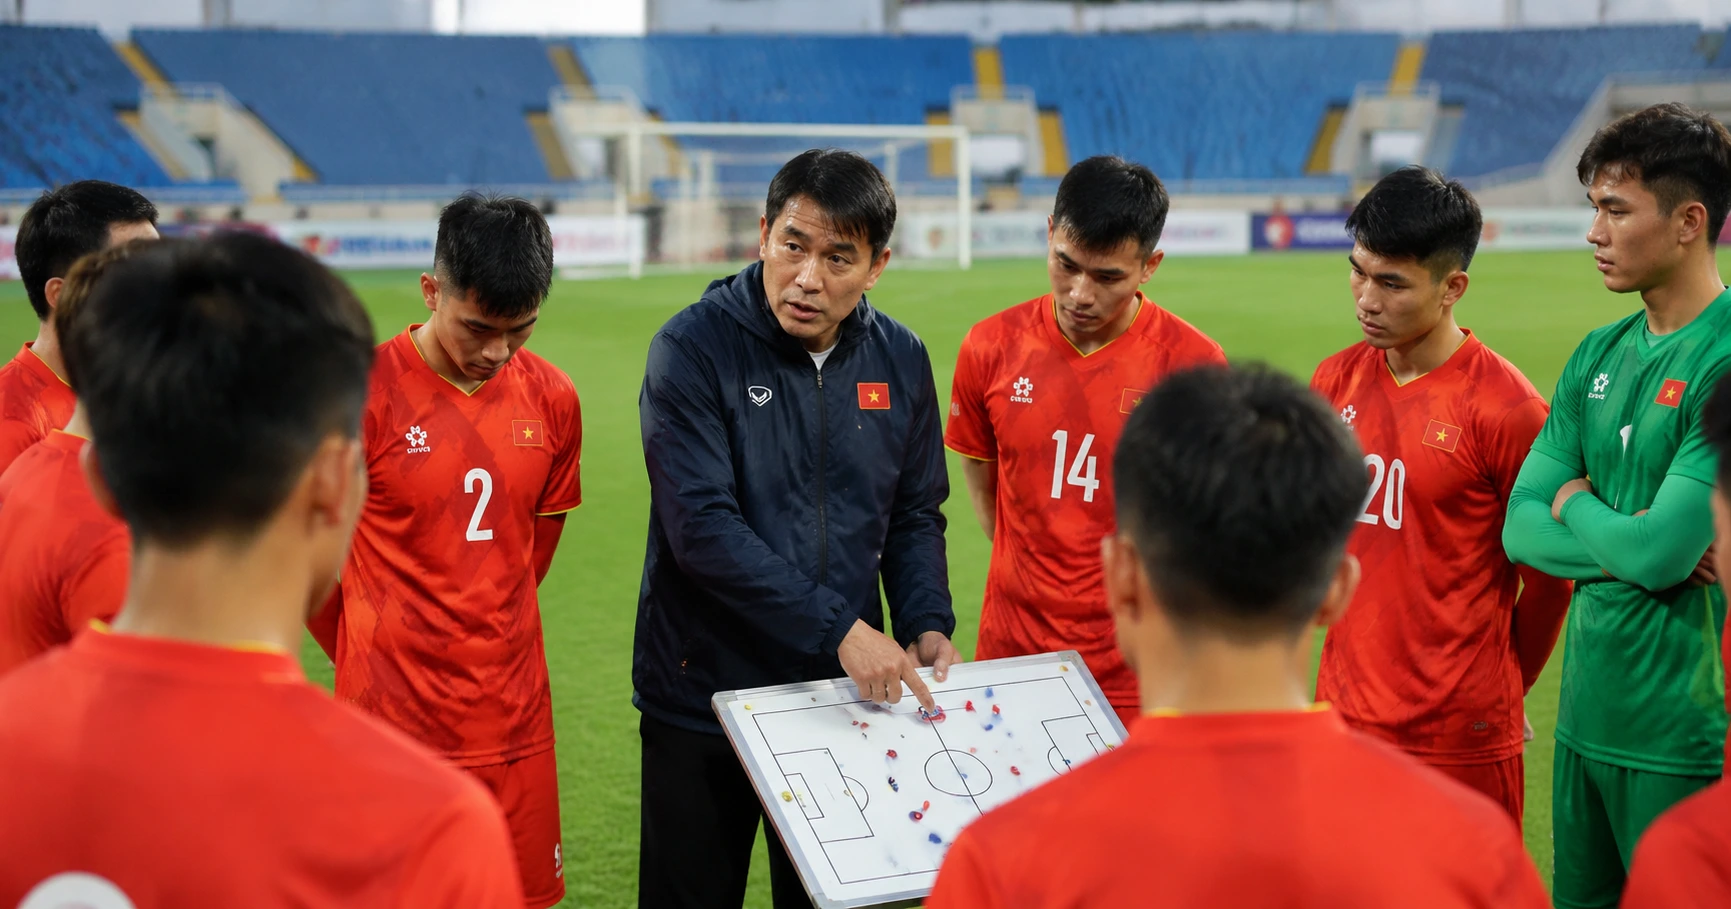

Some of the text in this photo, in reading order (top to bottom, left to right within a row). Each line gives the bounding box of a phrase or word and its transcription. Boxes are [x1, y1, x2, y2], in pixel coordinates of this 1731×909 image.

[1050, 429, 1100, 503] 14
[1355, 453, 1406, 530] 20
[464, 467, 494, 542] 2
